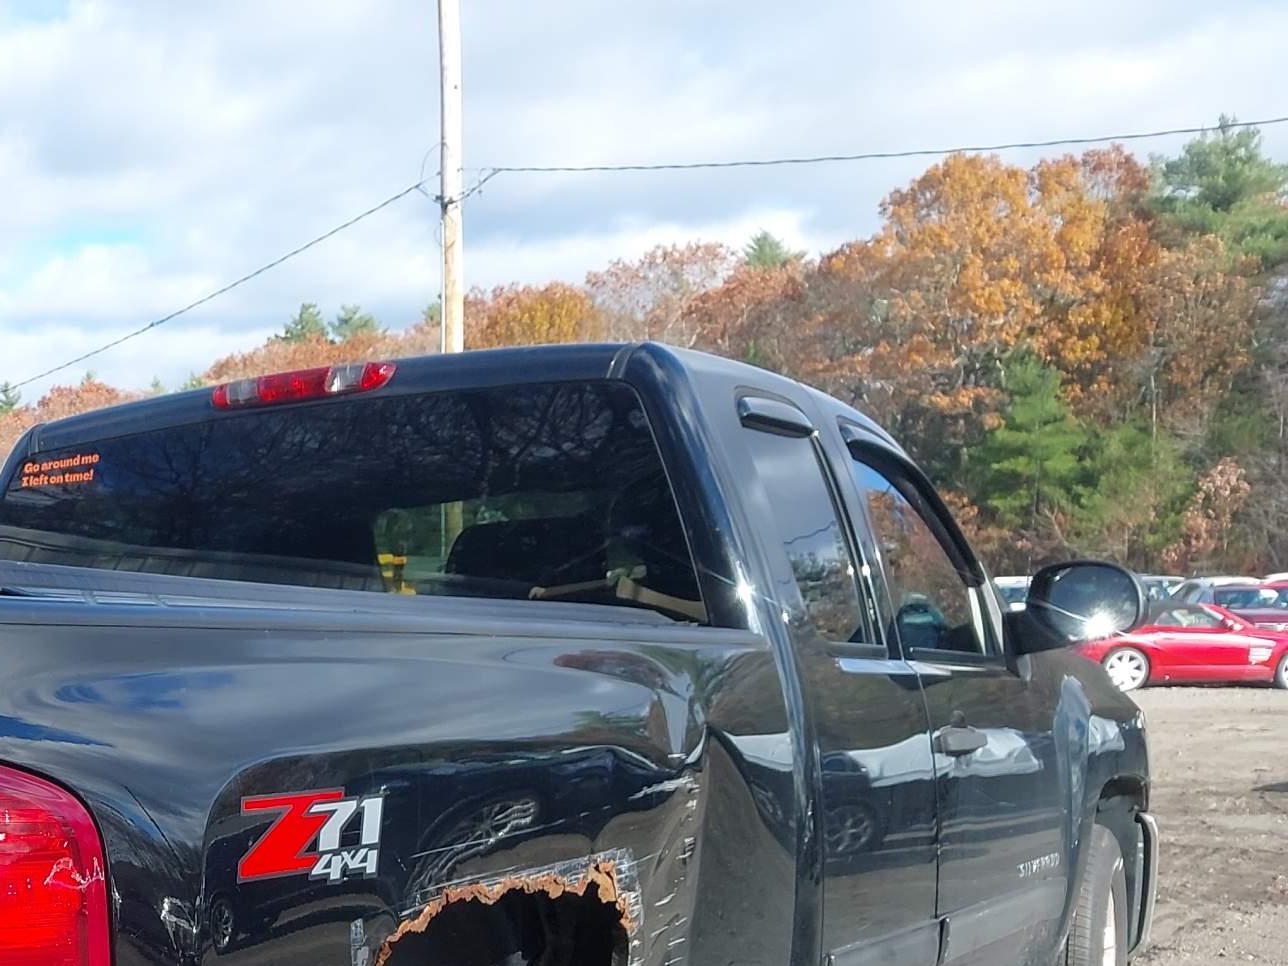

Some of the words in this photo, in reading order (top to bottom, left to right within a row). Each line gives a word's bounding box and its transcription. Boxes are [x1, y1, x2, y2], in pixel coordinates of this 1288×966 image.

[23, 462, 40, 474] Go
[41, 454, 81, 471] around
[81, 453, 100, 465] me
[22, 476, 30, 487] I
[29, 473, 49, 487] left
[49, 475, 64, 485] on
[64, 468, 94, 483] time!
[239, 788, 383, 880] Z71
